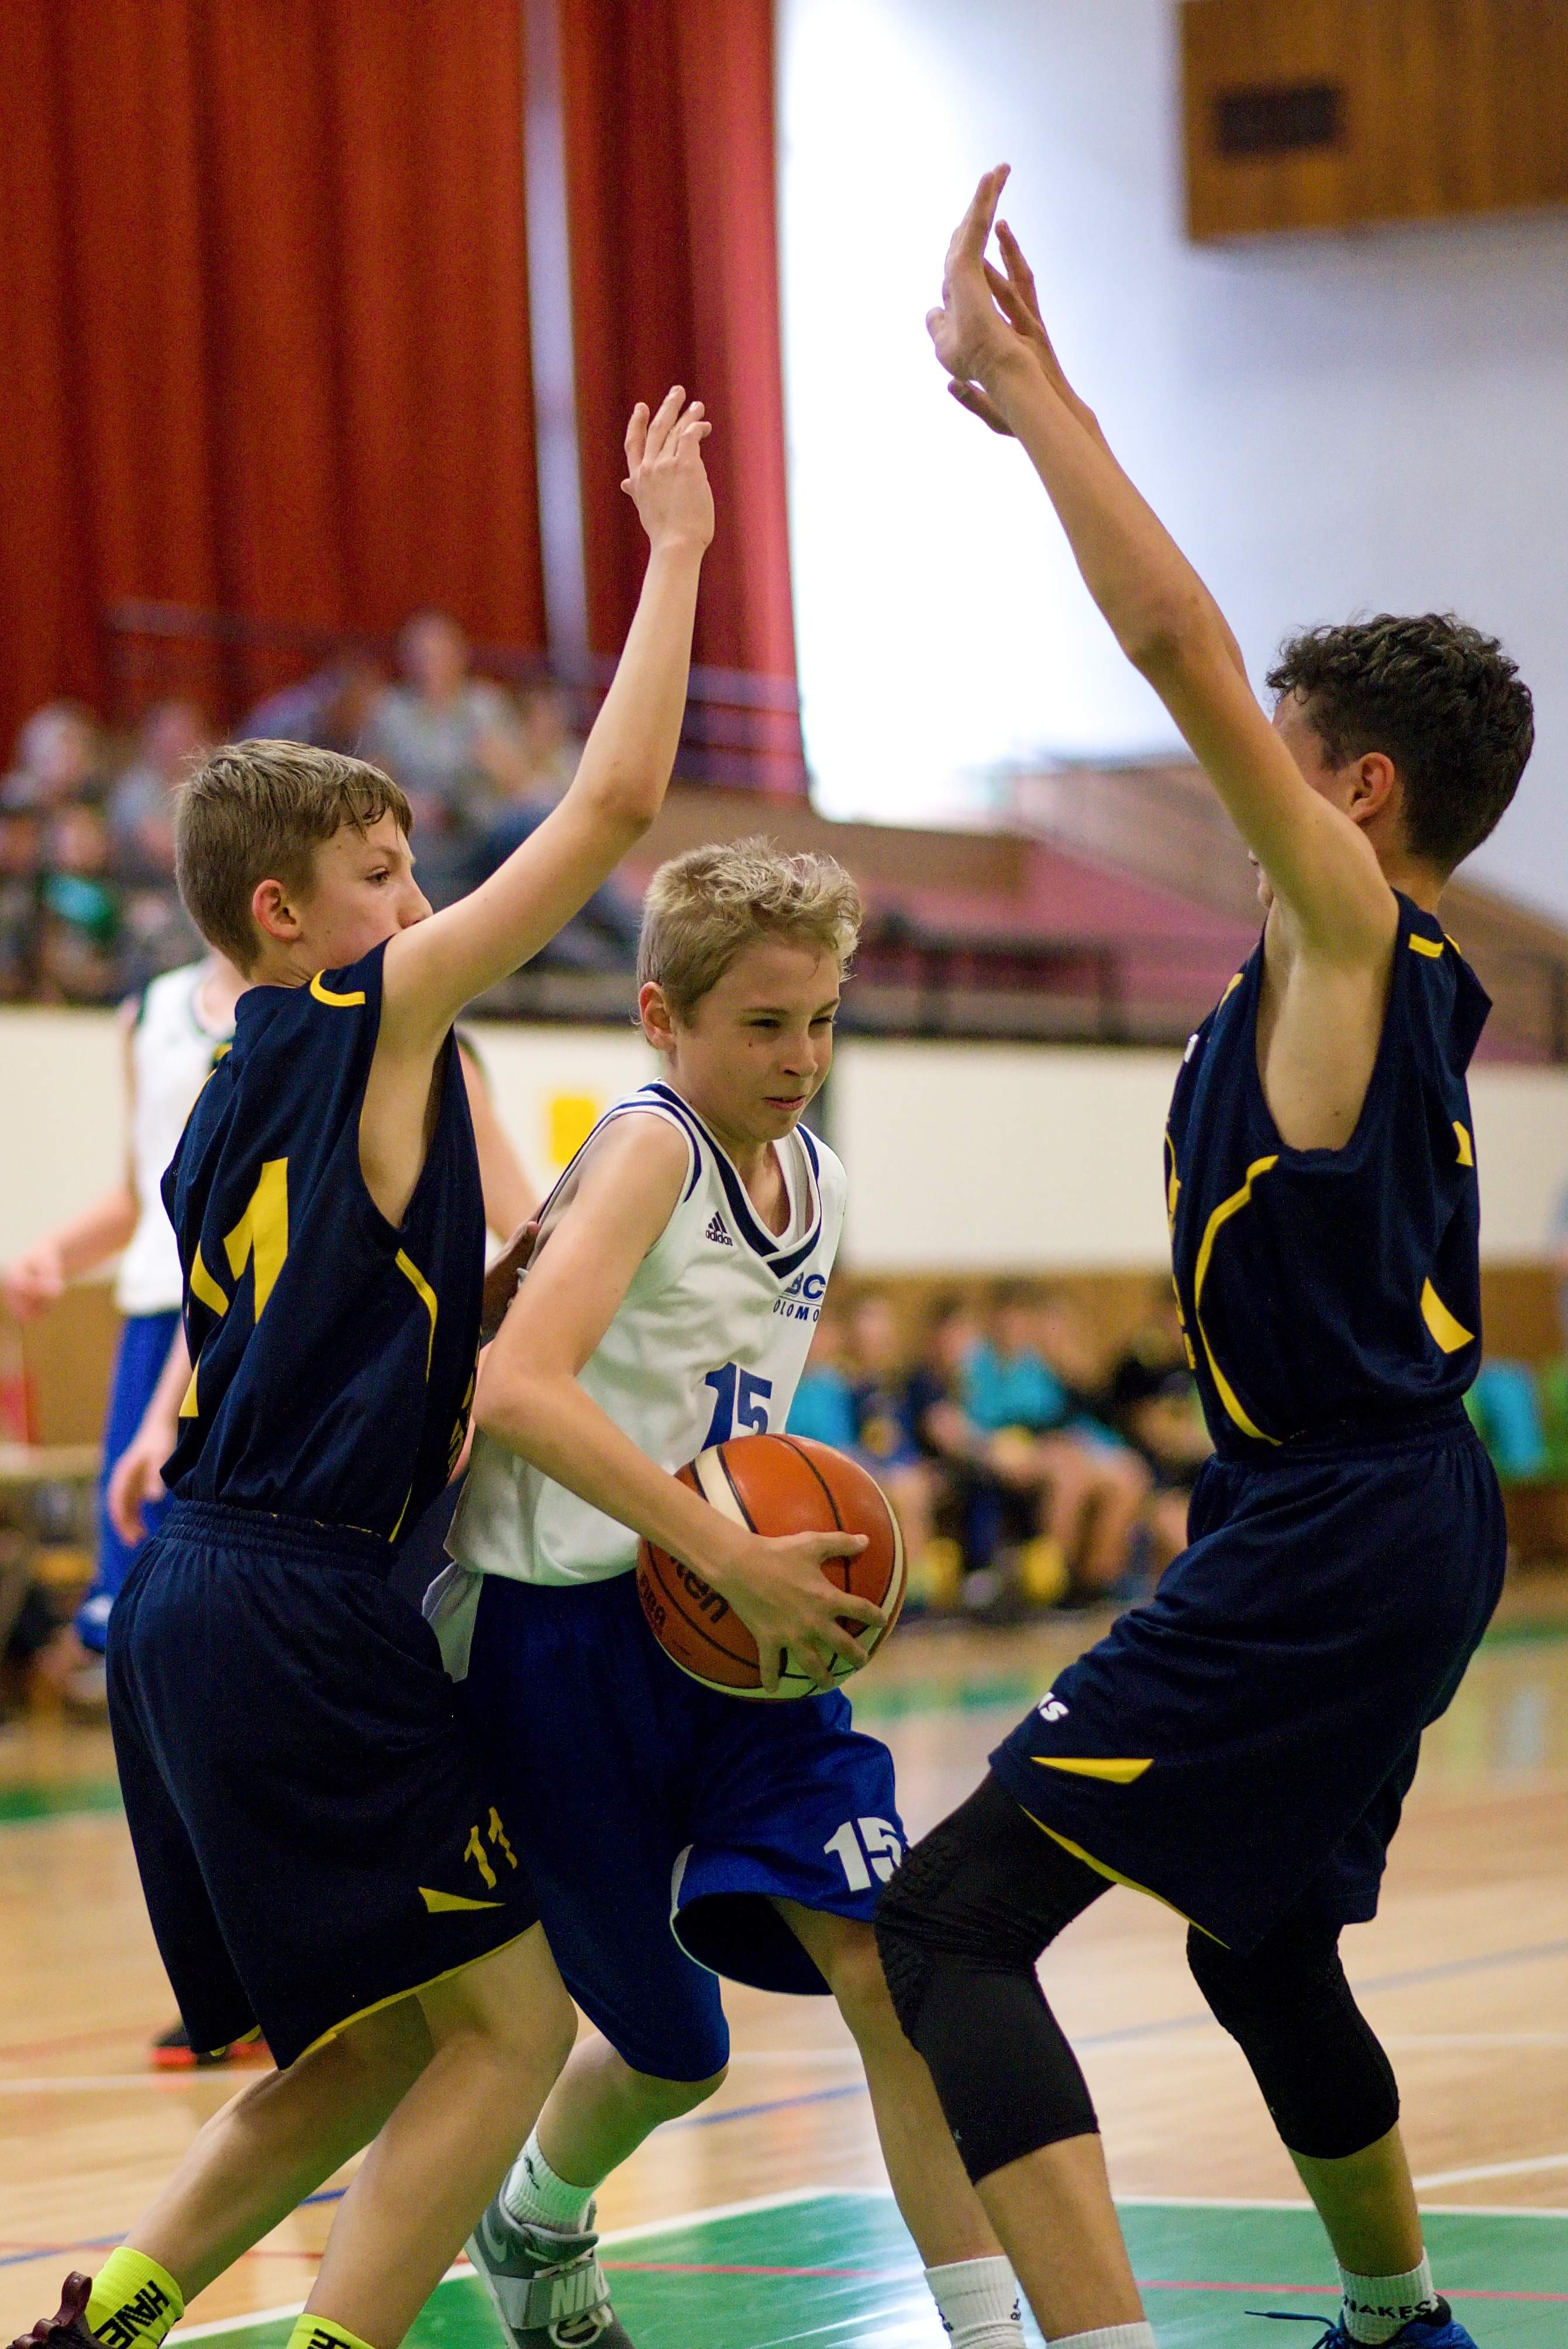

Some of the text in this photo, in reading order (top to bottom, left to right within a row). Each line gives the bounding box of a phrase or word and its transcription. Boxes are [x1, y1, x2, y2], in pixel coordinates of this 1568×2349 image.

[701, 1361, 773, 1453] 15
[464, 1806, 516, 1889] 11
[823, 1817, 902, 1892] 15
[92, 2280, 170, 2349] HAVE
